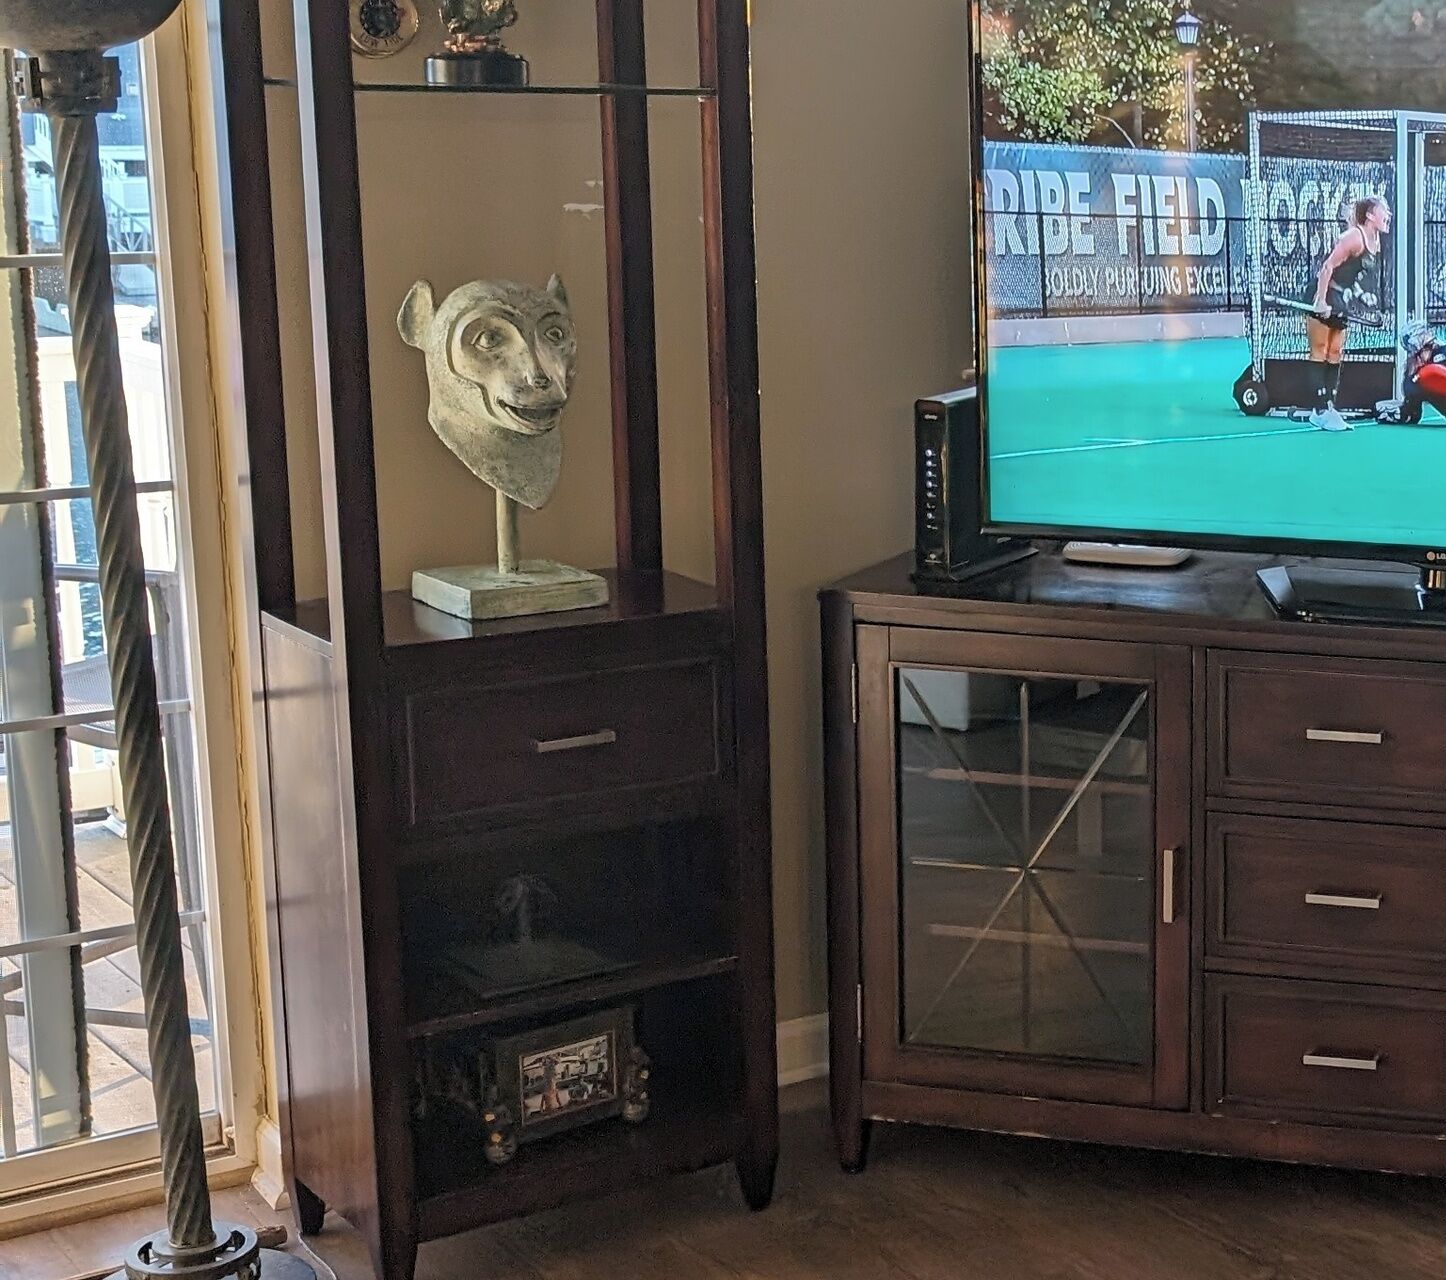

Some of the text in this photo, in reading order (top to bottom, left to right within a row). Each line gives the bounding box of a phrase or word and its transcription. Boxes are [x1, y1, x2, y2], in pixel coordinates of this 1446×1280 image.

[984, 169, 1095, 255] RIBE
[1110, 173, 1225, 256] FIELD
[1104, 265, 1182, 296] PURUING
